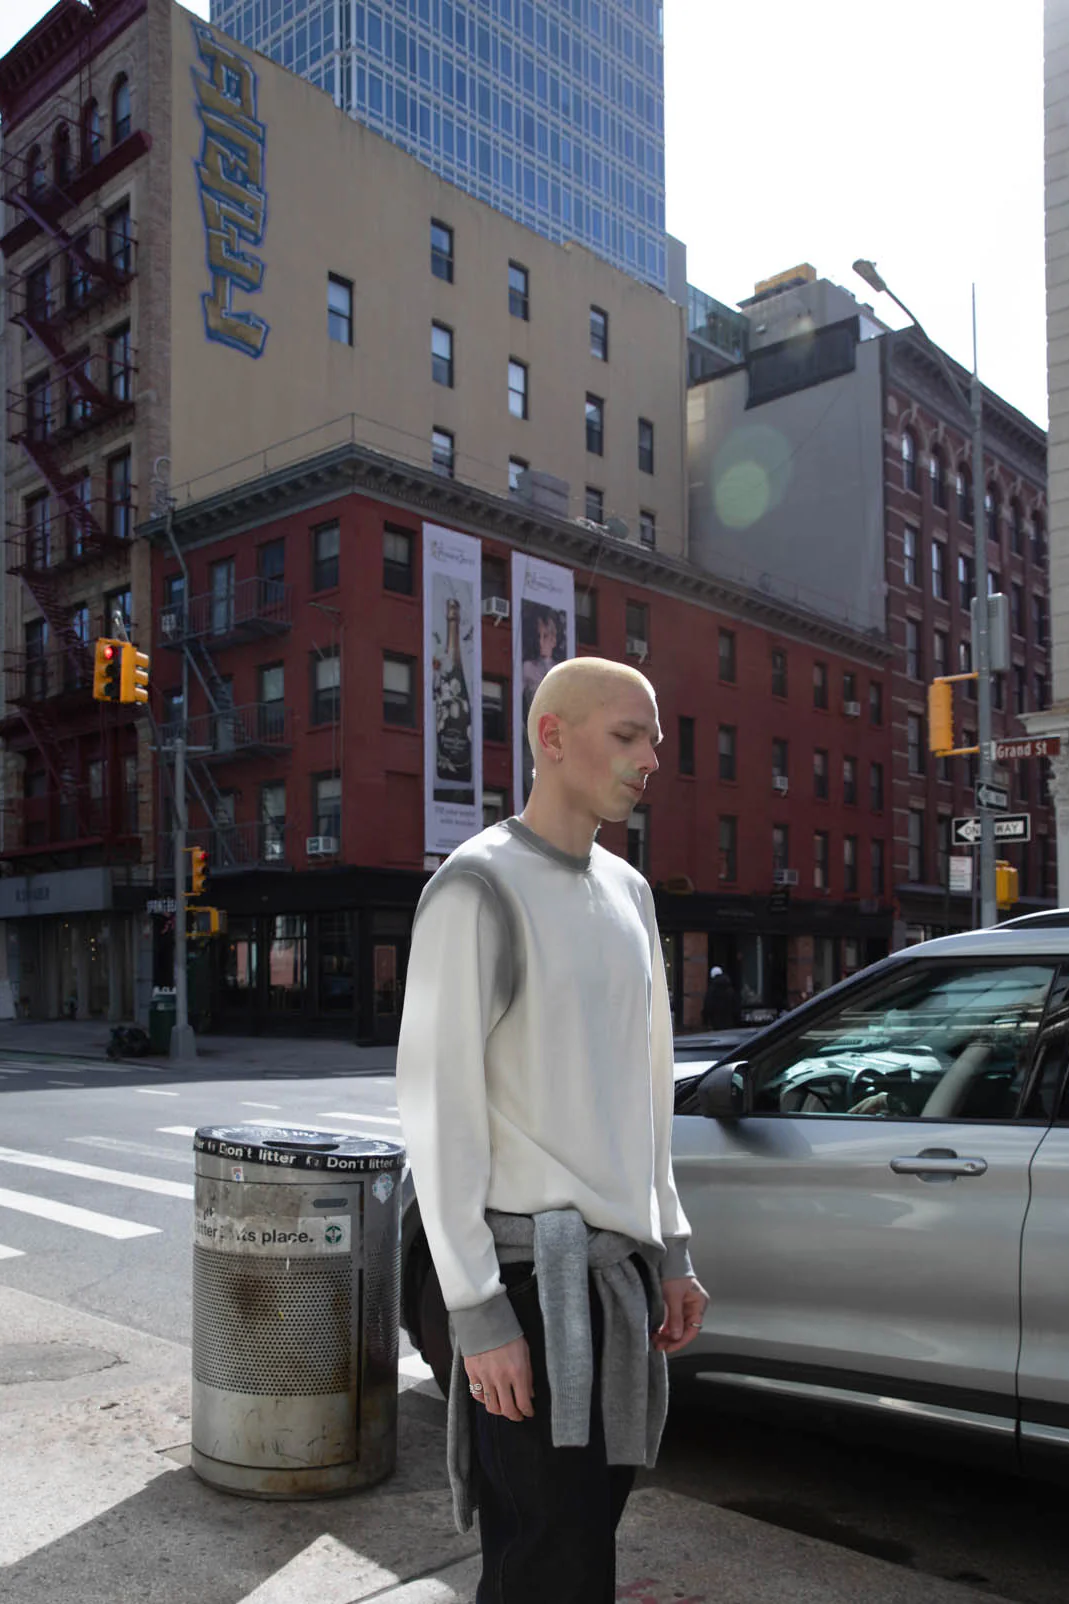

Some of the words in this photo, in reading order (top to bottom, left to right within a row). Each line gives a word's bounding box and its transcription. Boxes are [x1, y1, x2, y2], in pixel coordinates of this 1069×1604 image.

[997, 741, 1031, 758] Grand
[1035, 741, 1047, 756] St
[964, 825, 979, 835] ON
[996, 823, 1019, 834] WAY
[219, 1142, 252, 1159] Don't
[258, 1148, 296, 1164] litter
[327, 1156, 365, 1169] Don't
[368, 1158, 393, 1169] litter
[262, 1229, 314, 1246] place.
